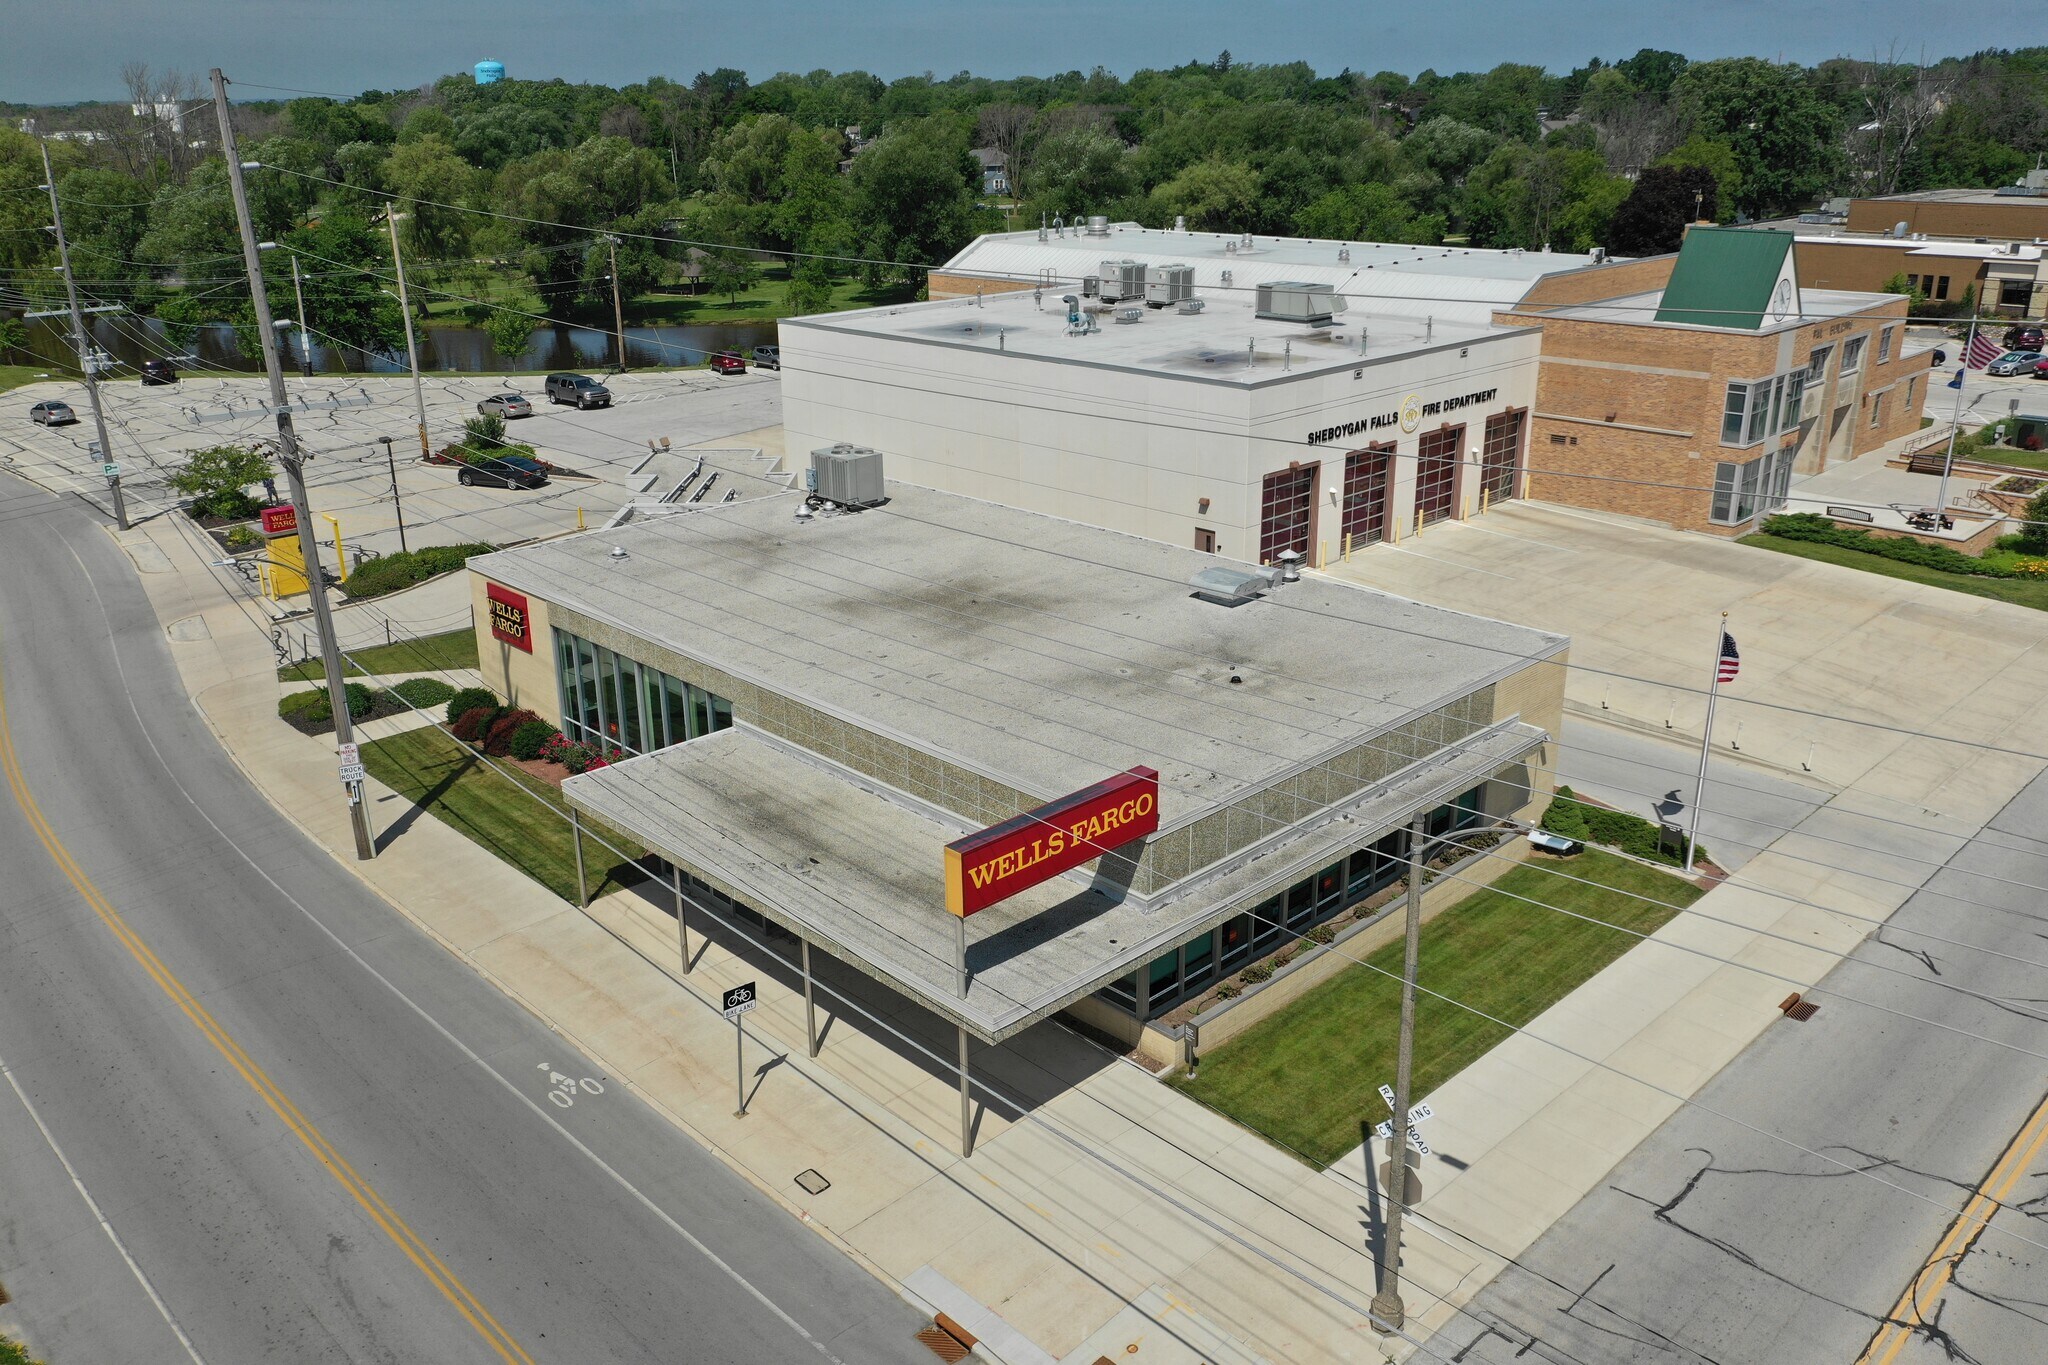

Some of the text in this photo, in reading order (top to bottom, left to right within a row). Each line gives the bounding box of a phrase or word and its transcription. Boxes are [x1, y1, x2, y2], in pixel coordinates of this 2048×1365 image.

[1308, 419, 1367, 445] SHEBOYGAN
[1370, 411, 1398, 431] FALLS
[1422, 402, 1441, 418] FIRE
[1443, 388, 1497, 413] DEPARTMENT
[271, 513, 295, 522] WELL
[273, 520, 297, 528] FARG
[488, 599, 520, 622] WELLS
[490, 614, 521, 638] FARGO
[340, 765, 362, 774] TRUCK
[341, 772, 363, 780] ROUTE
[968, 793, 1153, 890] WELLS FARGO
[726, 1002, 754, 1018] BIKE LANE
